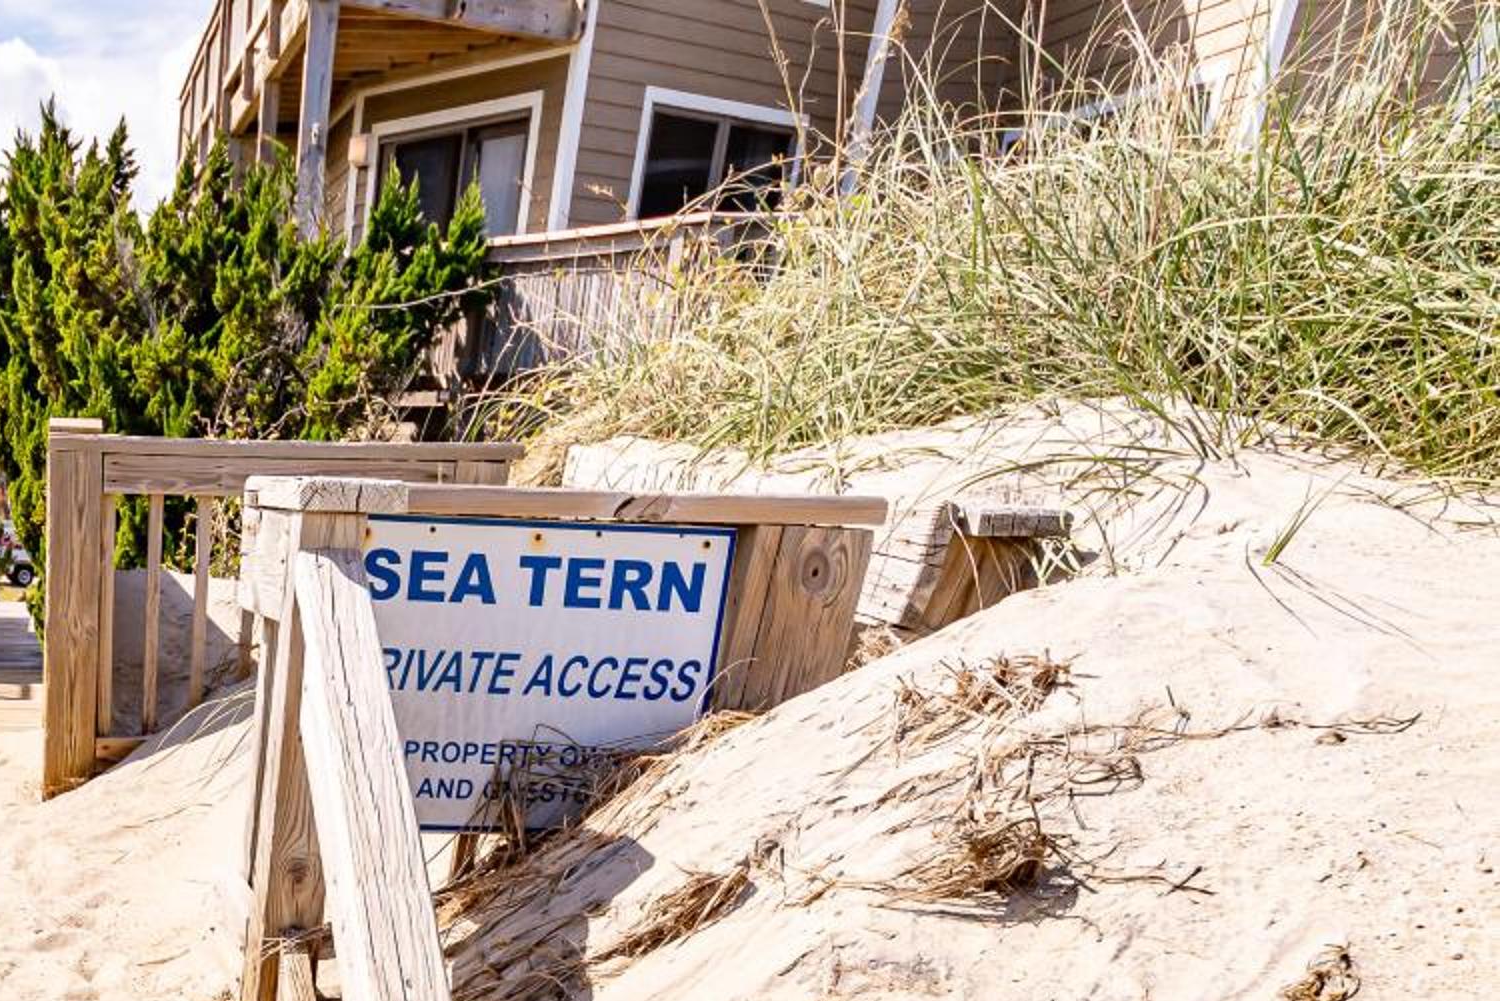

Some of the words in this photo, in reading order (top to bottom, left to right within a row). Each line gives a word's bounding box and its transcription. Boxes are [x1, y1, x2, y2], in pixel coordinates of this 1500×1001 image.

[364, 548, 497, 604] SEA
[520, 555, 707, 613] TERN
[381, 647, 521, 695] RIVATE
[522, 654, 701, 702] ACCESS
[404, 740, 551, 768] PROPERTY
[416, 778, 473, 799] AND
